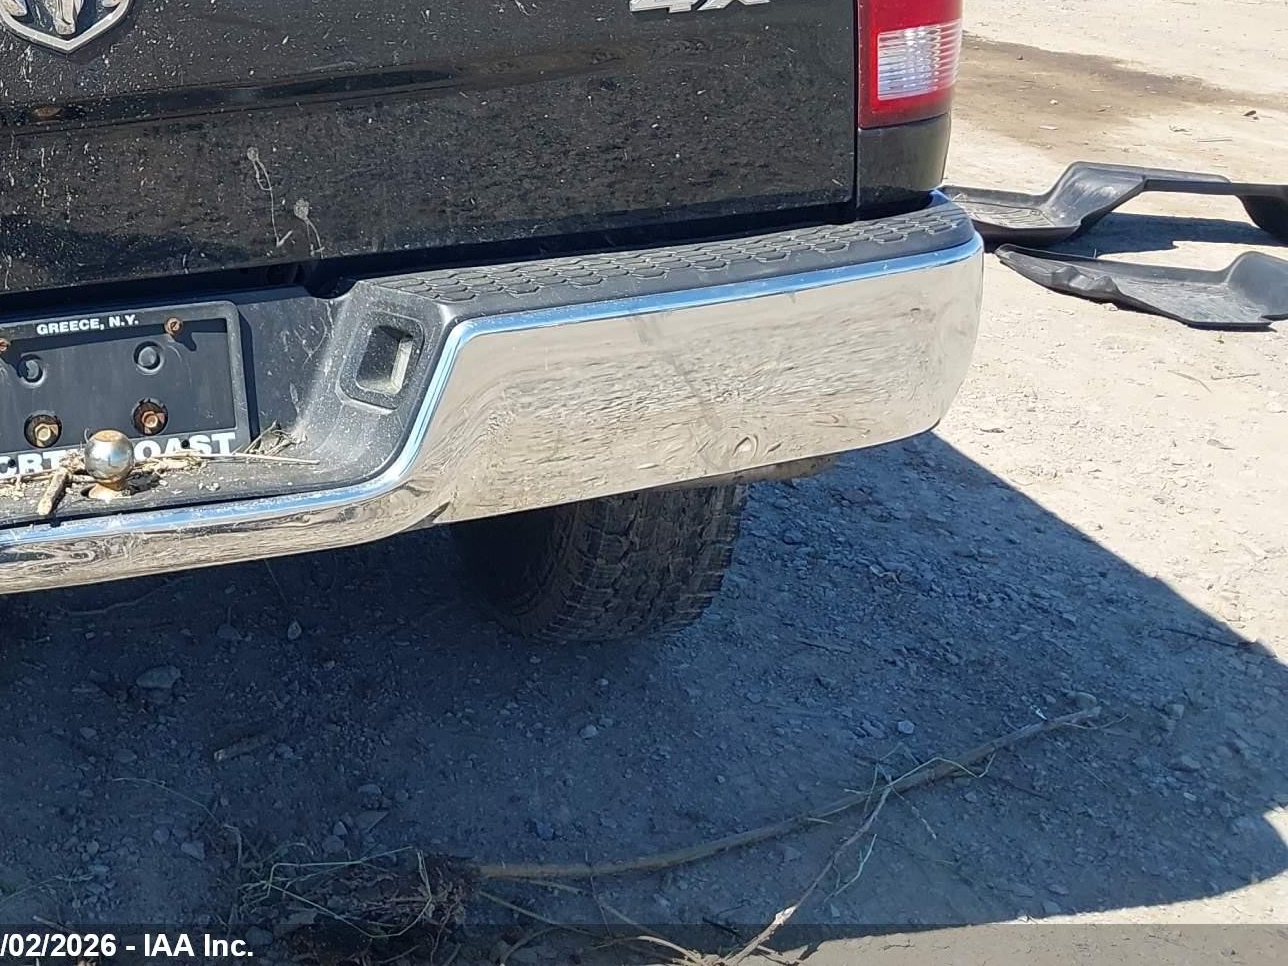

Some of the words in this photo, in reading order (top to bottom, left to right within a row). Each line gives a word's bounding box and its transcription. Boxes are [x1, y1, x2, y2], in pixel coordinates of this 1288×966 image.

[36, 318, 105, 335] GREECE,
[108, 314, 139, 328] N.Y.
[133, 432, 236, 462] OAST
